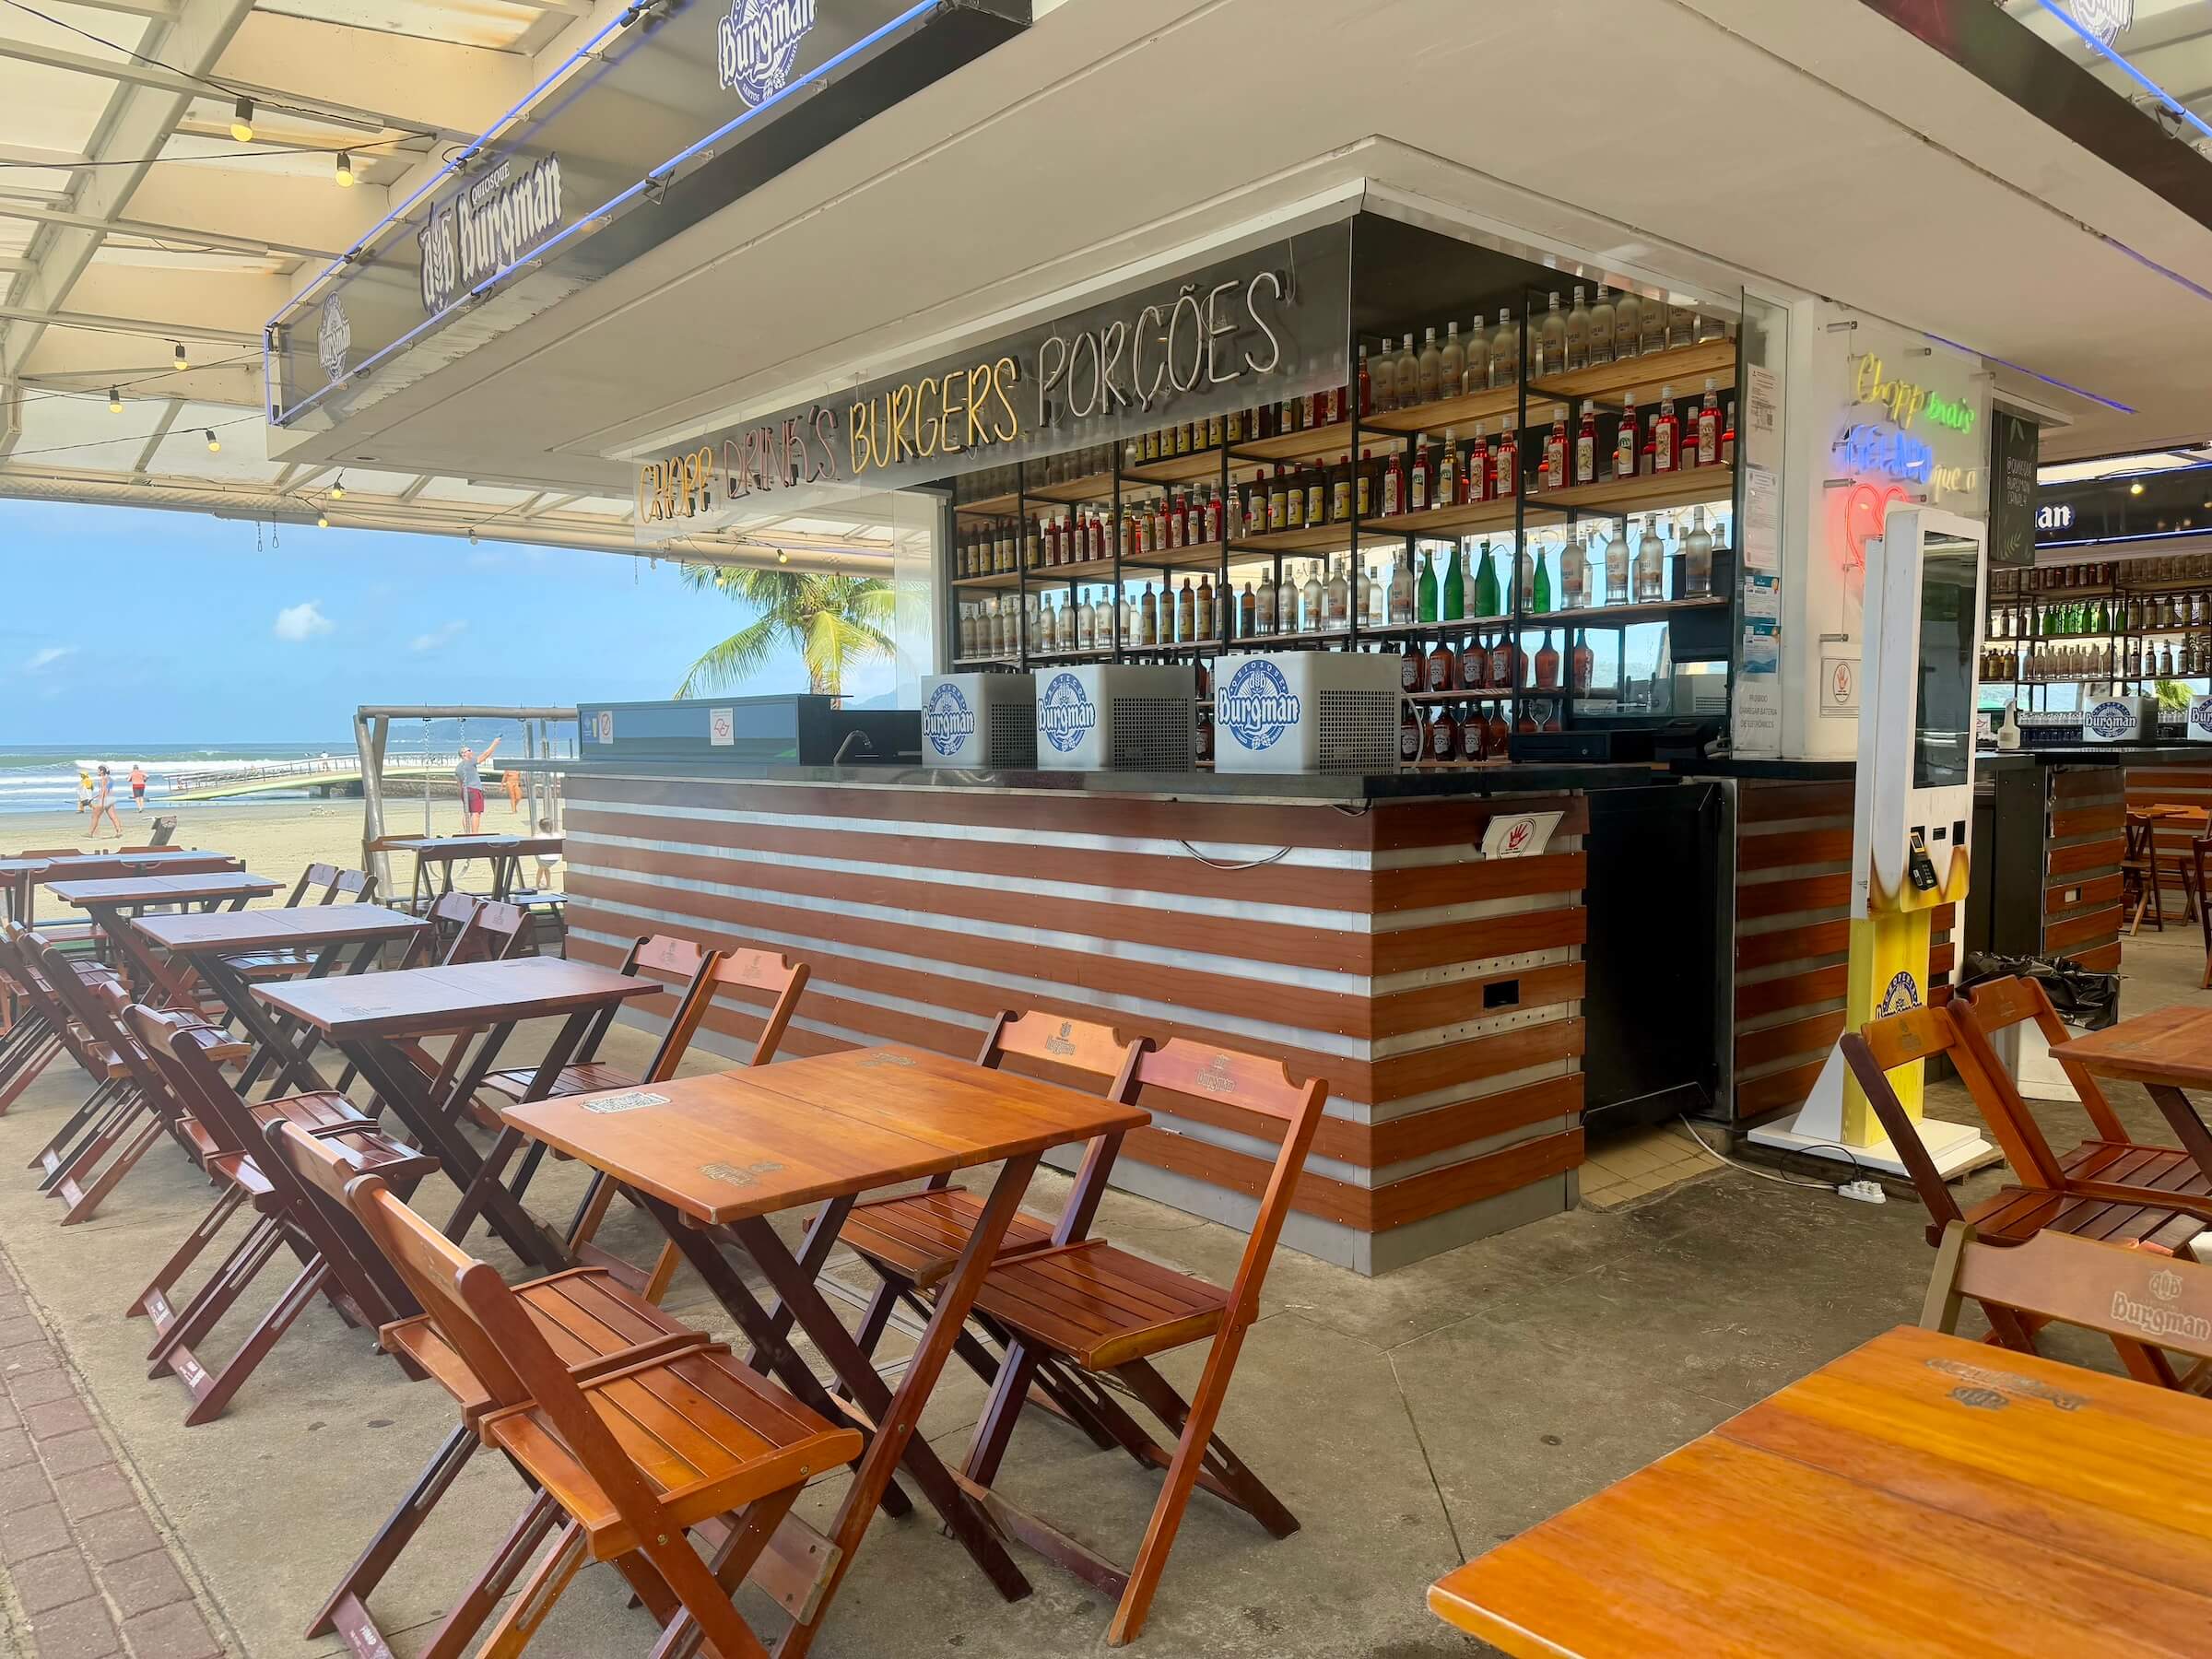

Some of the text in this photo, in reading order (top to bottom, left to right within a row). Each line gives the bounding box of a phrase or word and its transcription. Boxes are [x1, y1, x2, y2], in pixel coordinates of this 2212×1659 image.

[742, 83, 760, 102] SANTOS
[471, 161, 510, 203] QUIOSQUE
[640, 446, 713, 524] CHOPP
[849, 357, 1018, 474] BURGERS
[1039, 272, 1281, 427] PORÇÕES
[1858, 353, 1975, 435] Chopp mais
[2035, 505, 2072, 530] an
[1230, 661, 1285, 688] QUIOSQUE
